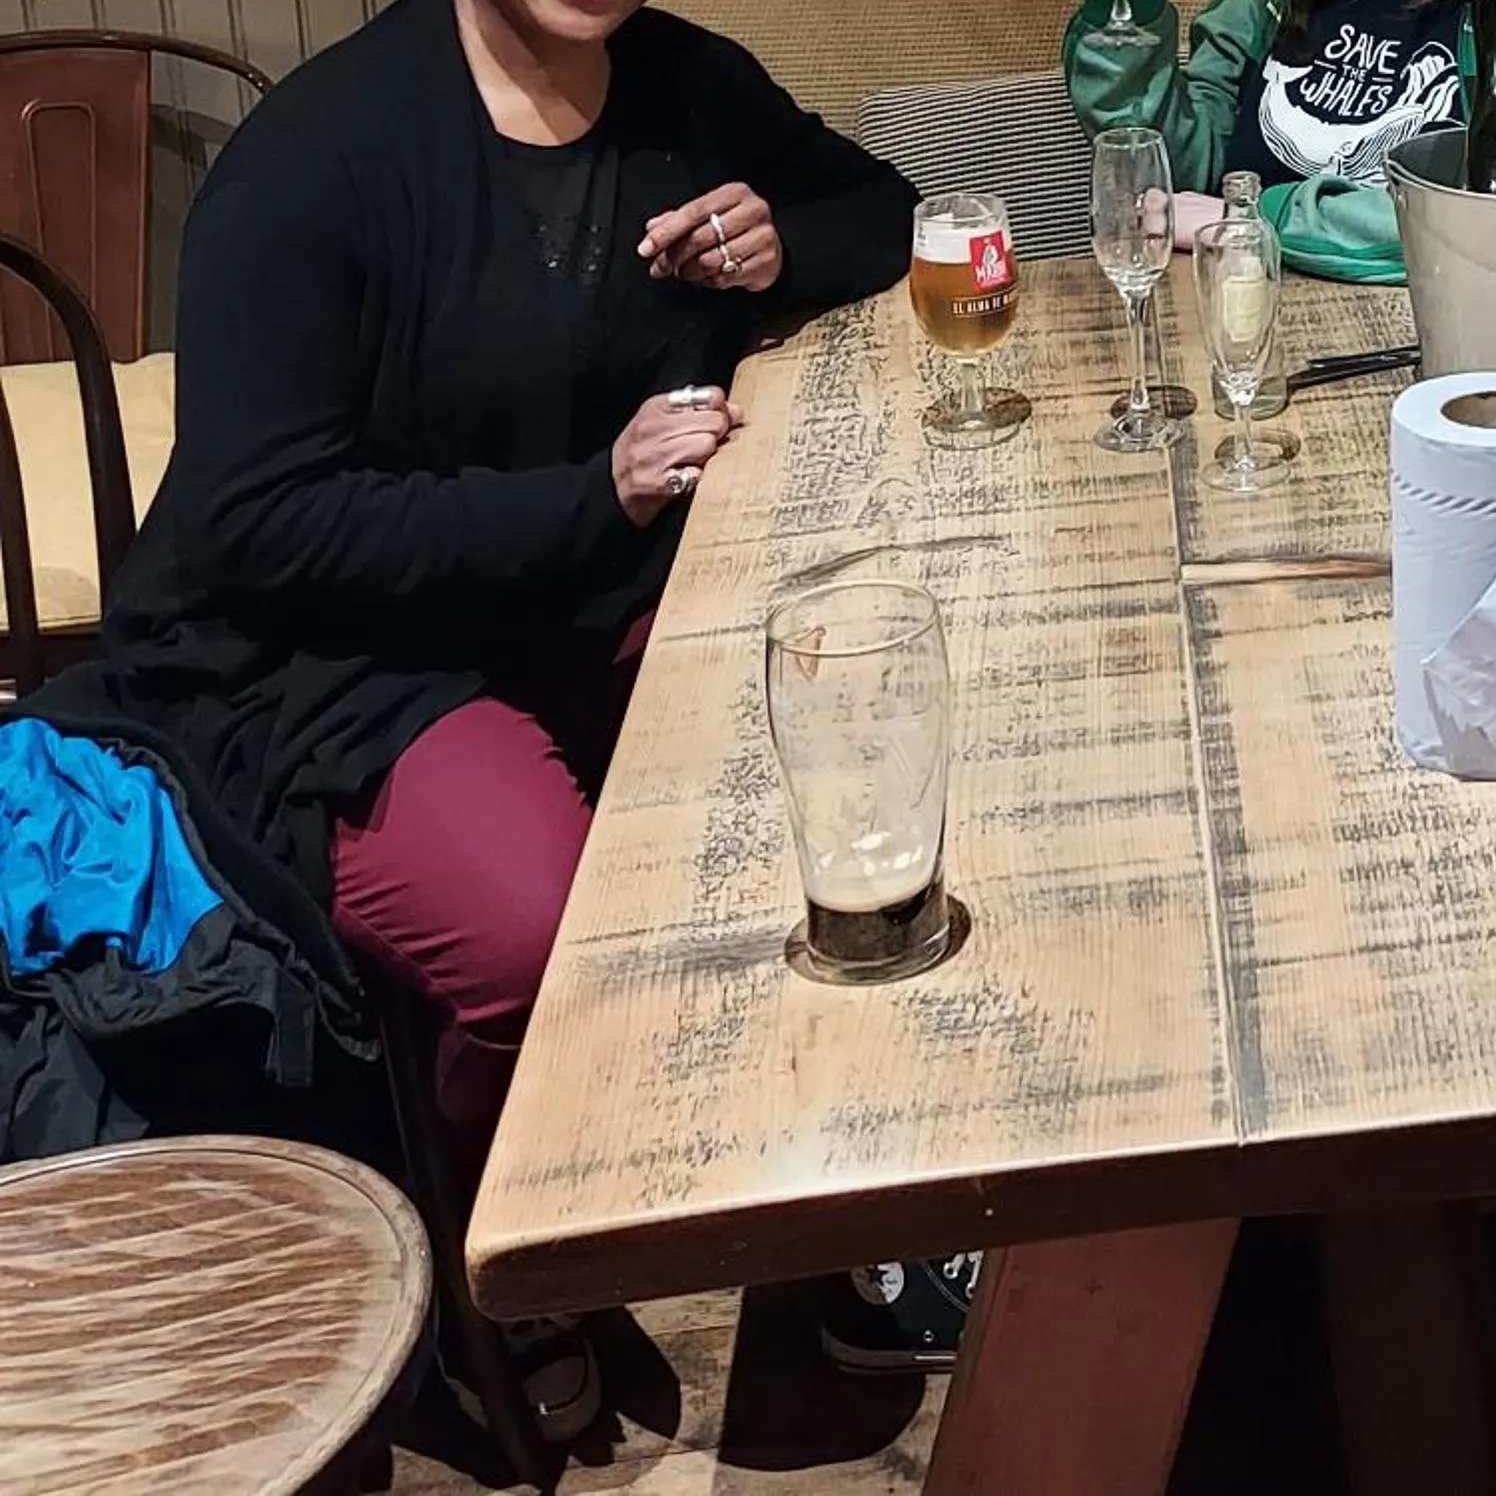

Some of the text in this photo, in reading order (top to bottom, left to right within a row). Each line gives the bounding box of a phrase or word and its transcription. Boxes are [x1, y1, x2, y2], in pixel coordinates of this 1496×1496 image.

[1324, 23, 1402, 75] SAVE
[1301, 71, 1393, 117] WHALES
[1341, 64, 1366, 84] THE
